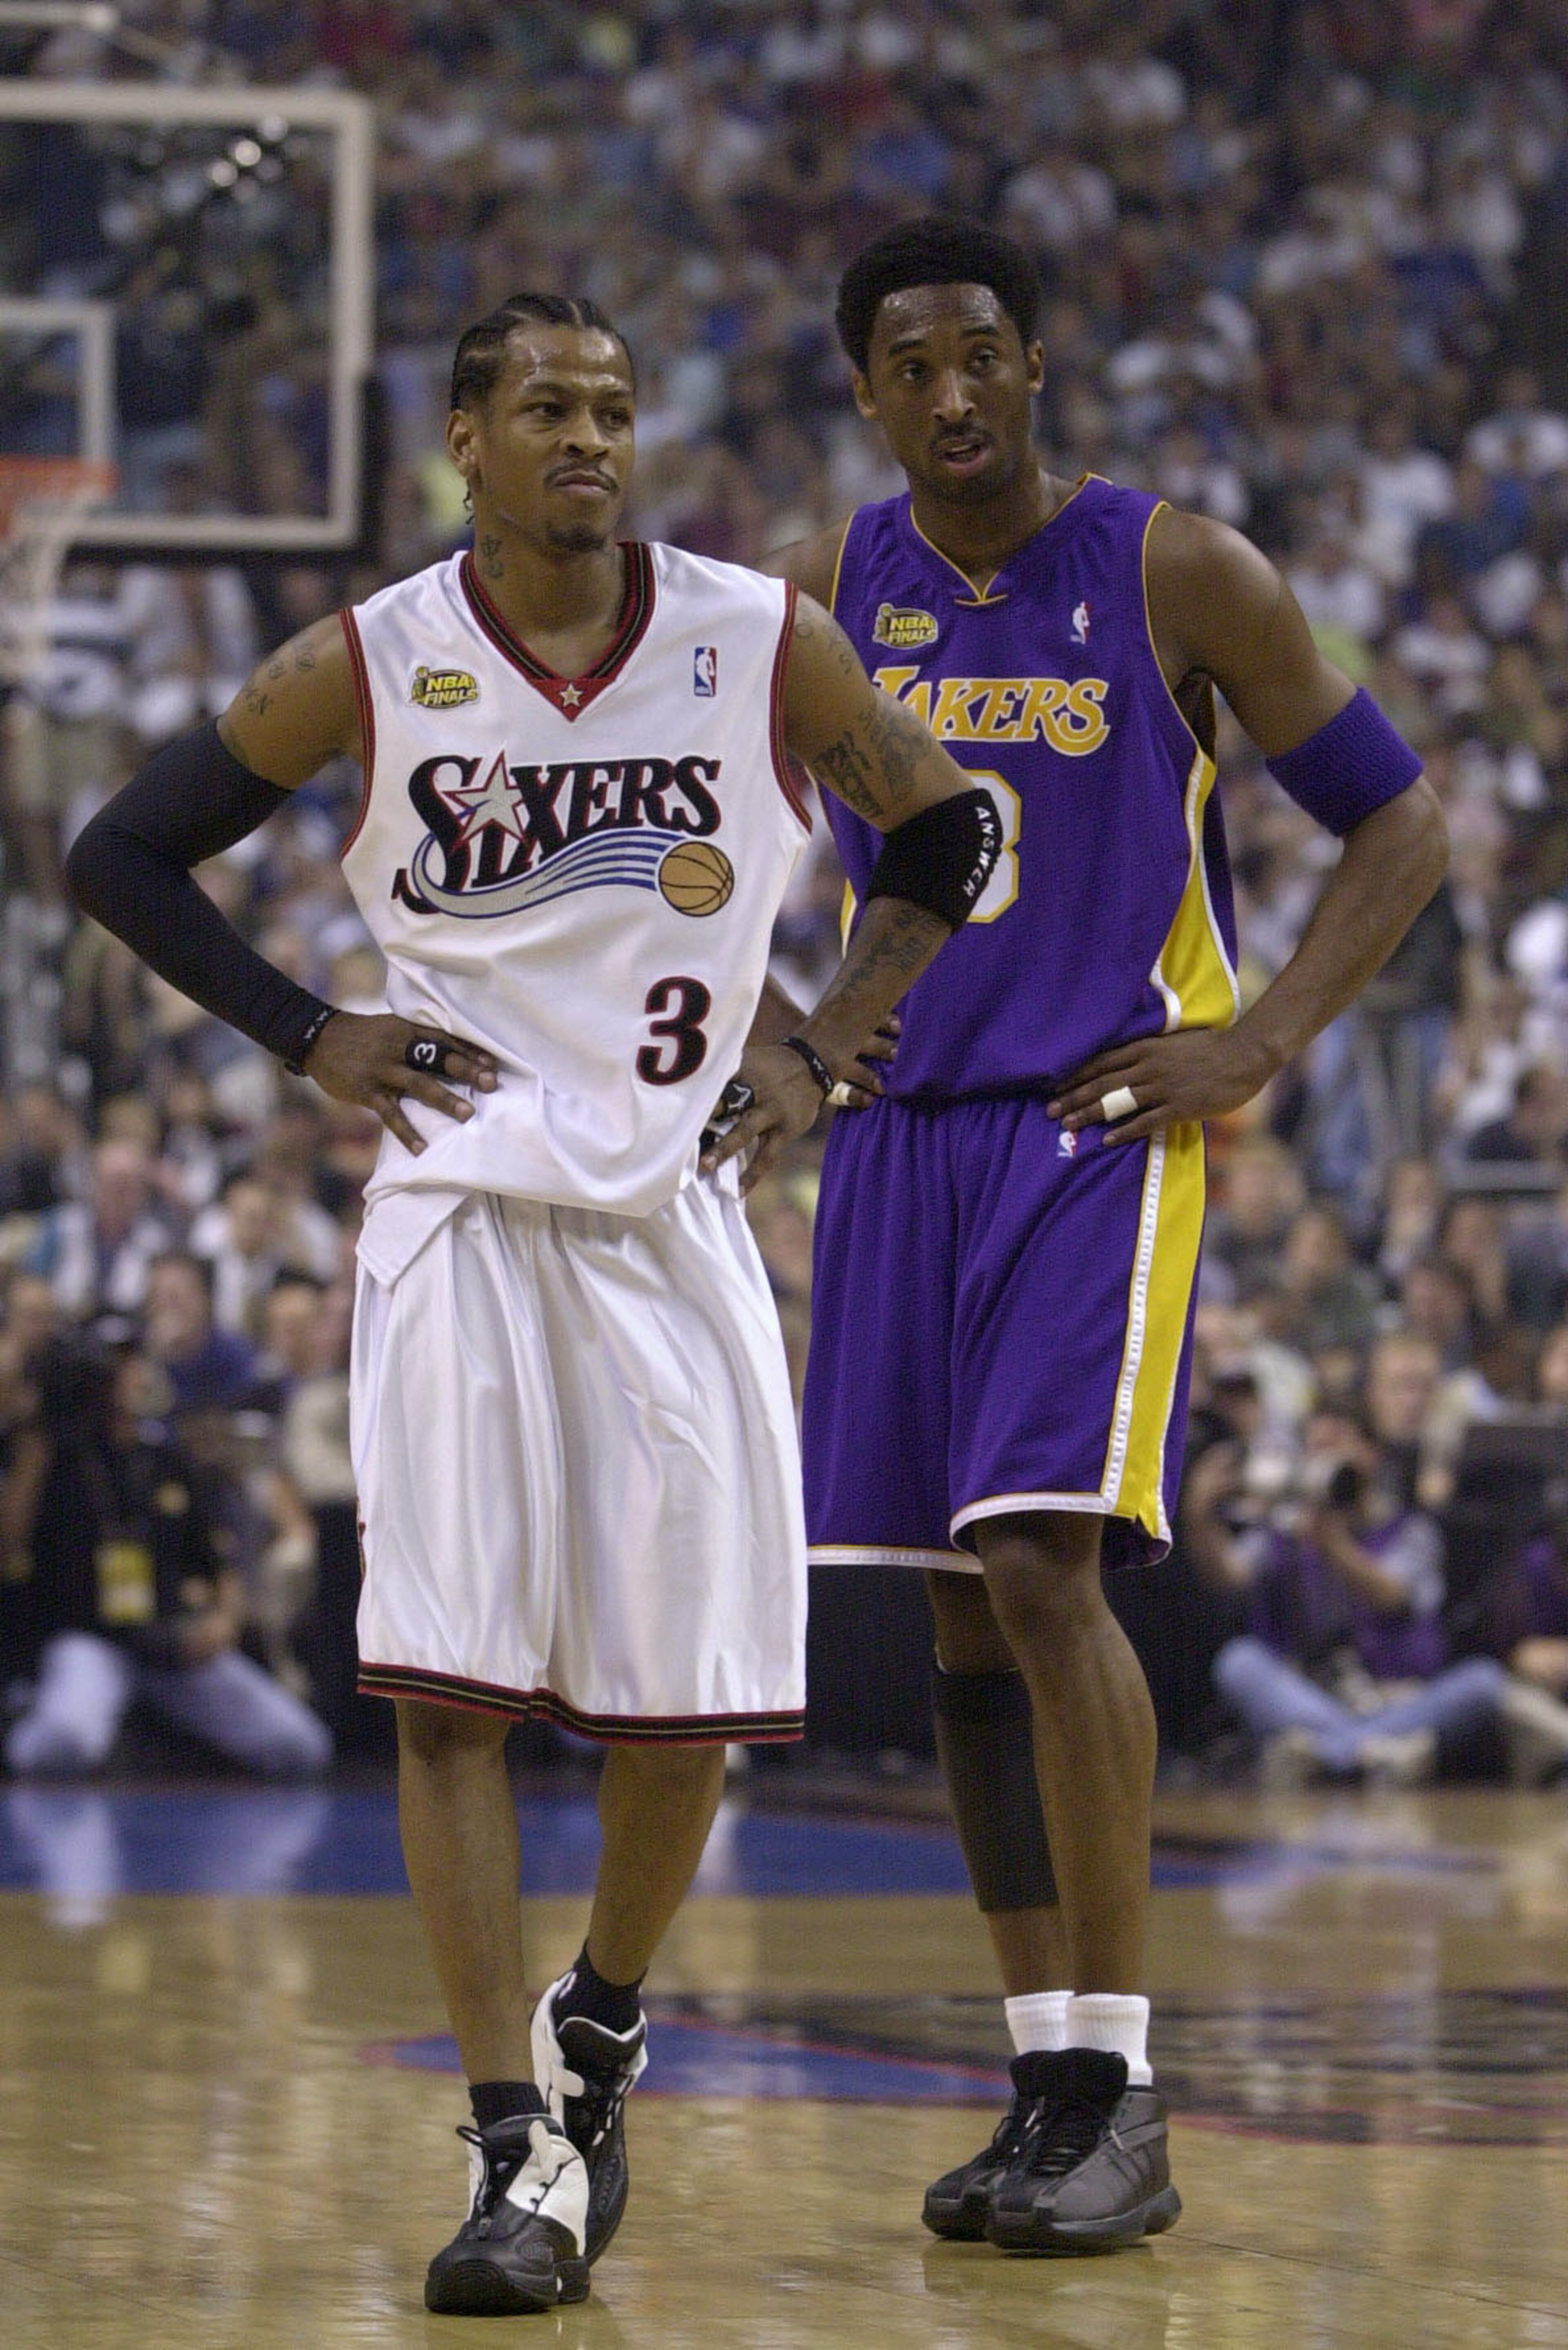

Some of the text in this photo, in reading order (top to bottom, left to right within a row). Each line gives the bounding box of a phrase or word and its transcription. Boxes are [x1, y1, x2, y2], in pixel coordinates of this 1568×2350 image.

[891, 615, 933, 630] NBA
[426, 675, 472, 691] NBA
[423, 689, 477, 705] FINALS
[391, 749, 722, 915] SIXERS
[635, 975, 711, 1086] 3
[414, 1043, 437, 1064] 3
